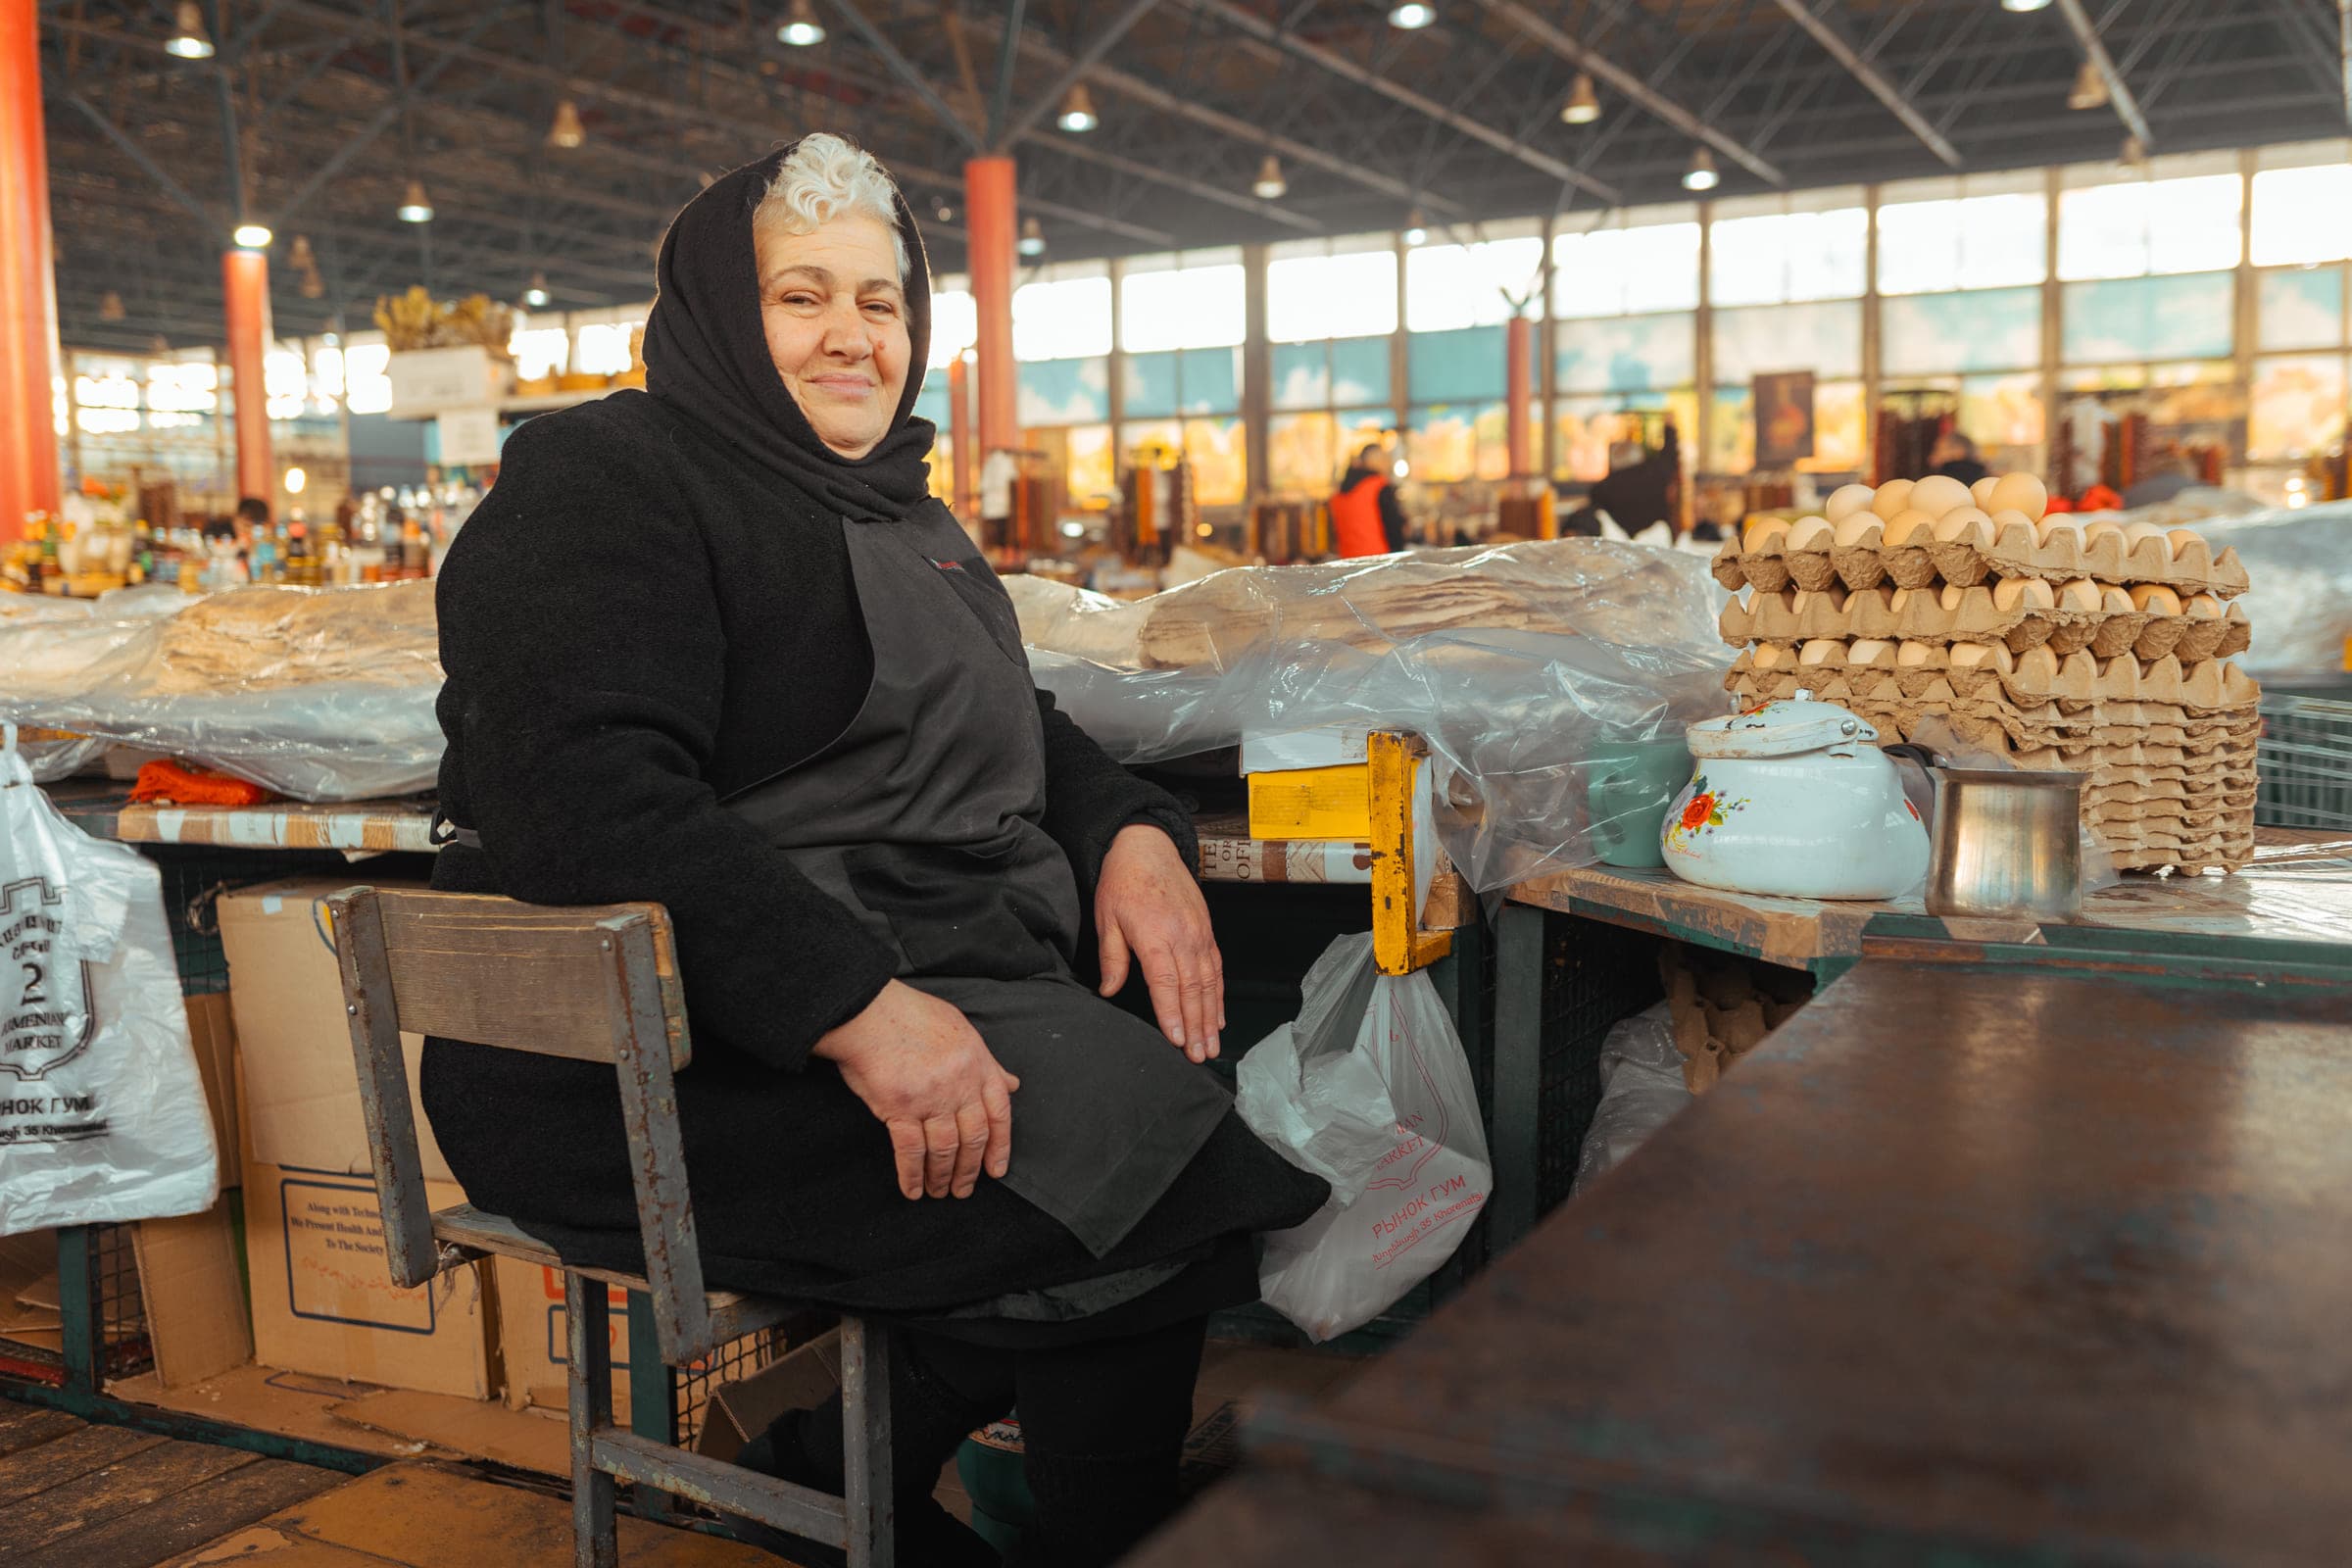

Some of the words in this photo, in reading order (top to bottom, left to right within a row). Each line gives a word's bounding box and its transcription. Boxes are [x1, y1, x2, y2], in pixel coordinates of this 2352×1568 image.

[4, 1035, 62, 1056] MARKET
[1, 1099, 44, 1115] НОК
[23, 1125, 39, 1136] 35
[308, 1201, 330, 1215] Along
[332, 1205, 350, 1215] with
[353, 1207, 381, 1218] Techno
[1372, 1194, 1428, 1240] РЫНОК
[1430, 1175, 1466, 1201] ГУМ
[1419, 1217, 1433, 1230] 35
[1433, 1192, 1485, 1221] Khorenatsi
[305, 1218, 335, 1231] Present
[336, 1222, 364, 1234] Health
[326, 1239, 336, 1250] To
[338, 1241, 353, 1251] The
[355, 1244, 383, 1255] Society
